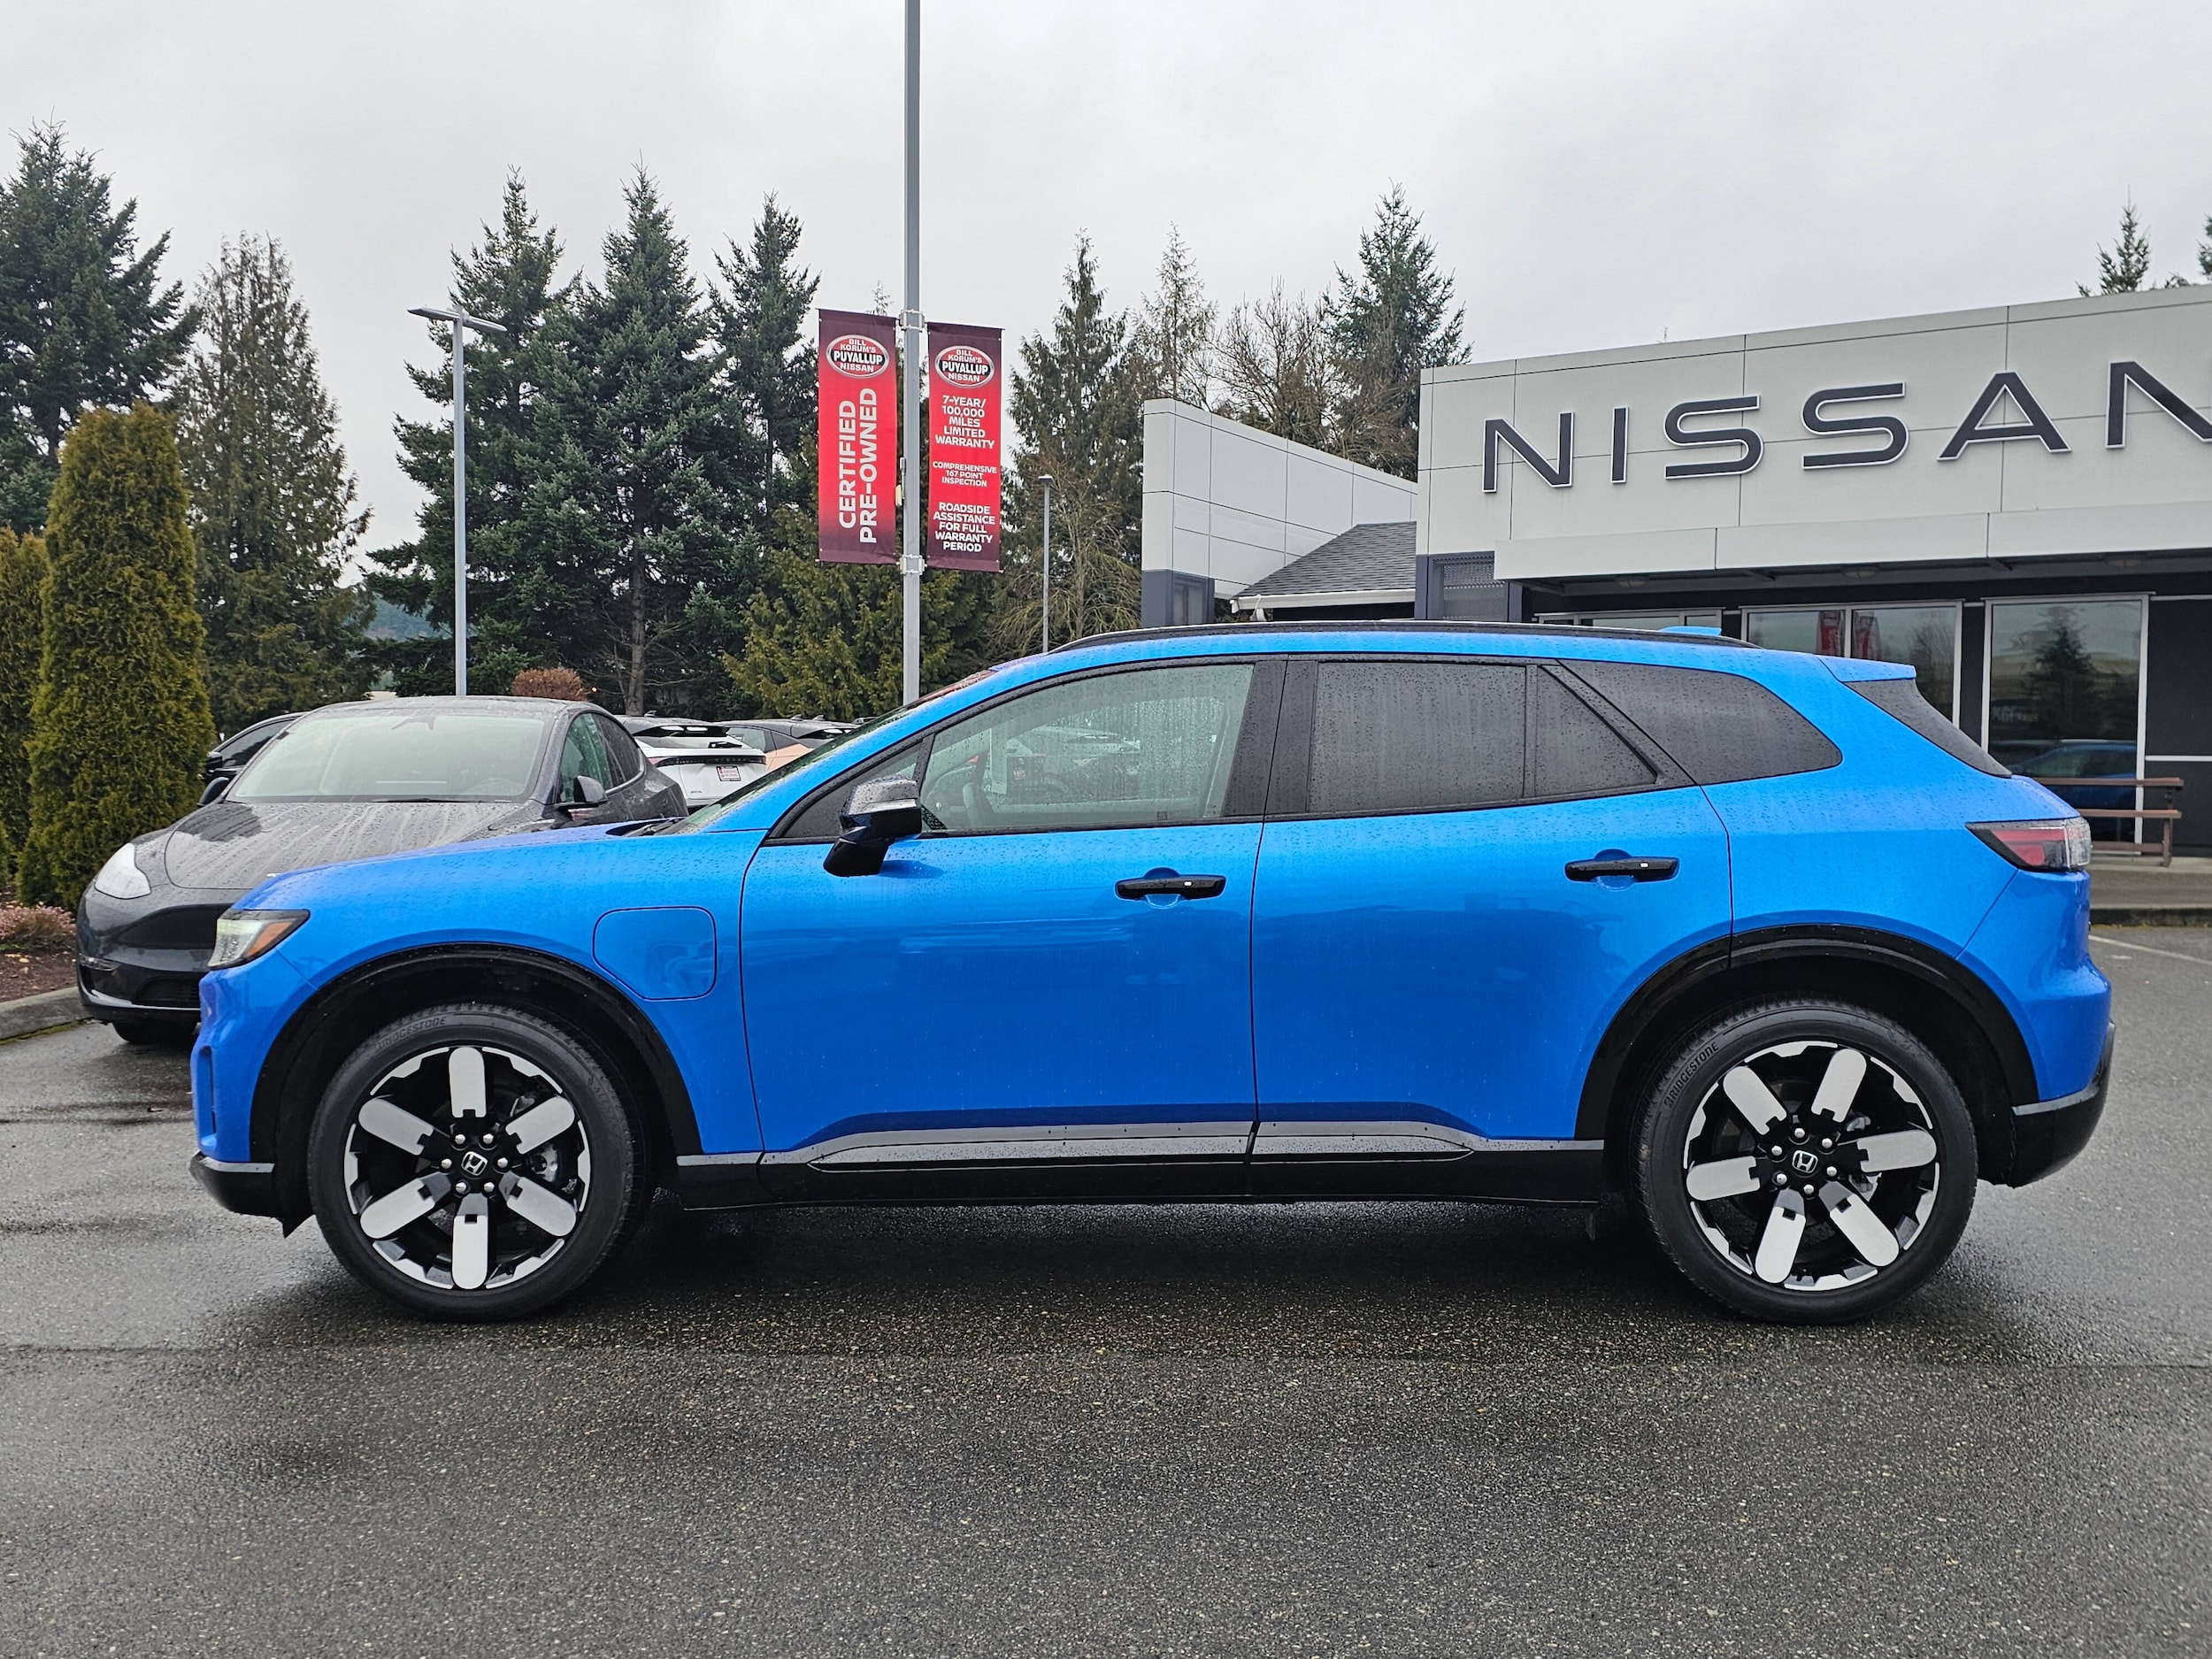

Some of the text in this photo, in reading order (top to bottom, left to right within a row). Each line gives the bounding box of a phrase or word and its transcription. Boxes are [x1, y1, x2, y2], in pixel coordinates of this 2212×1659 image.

[840, 343, 877, 353] KORUM'S
[833, 350, 883, 365] PUYALLUP
[948, 354, 982, 364] KORUM'S
[840, 363, 874, 373] NISSAN
[941, 360, 988, 375] PUYALLUP
[948, 373, 980, 382] NISSAN
[942, 395, 987, 409] 7-YEAR/
[941, 405, 985, 418] 100,000
[949, 416, 980, 427] MILES
[1483, 360, 2212, 493] NISSAN
[943, 426, 986, 438] LIMITED
[935, 434, 995, 449] WARRANTY
[839, 400, 856, 528] CERTIFIED
[859, 388, 878, 543] PRE-OWNED
[933, 461, 997, 473] COMPREHENSIVE
[941, 476, 987, 487] INSPECTION
[959, 471, 984, 480] POINT
[939, 502, 991, 514] ROADSIDE
[933, 511, 995, 525] ASSISTANCE
[939, 521, 987, 534] FOR FULL
[934, 531, 993, 543] WARRANTY
[943, 541, 982, 552] PERIOD
[1663, 1041, 1719, 1109] BRIDGESTONE
